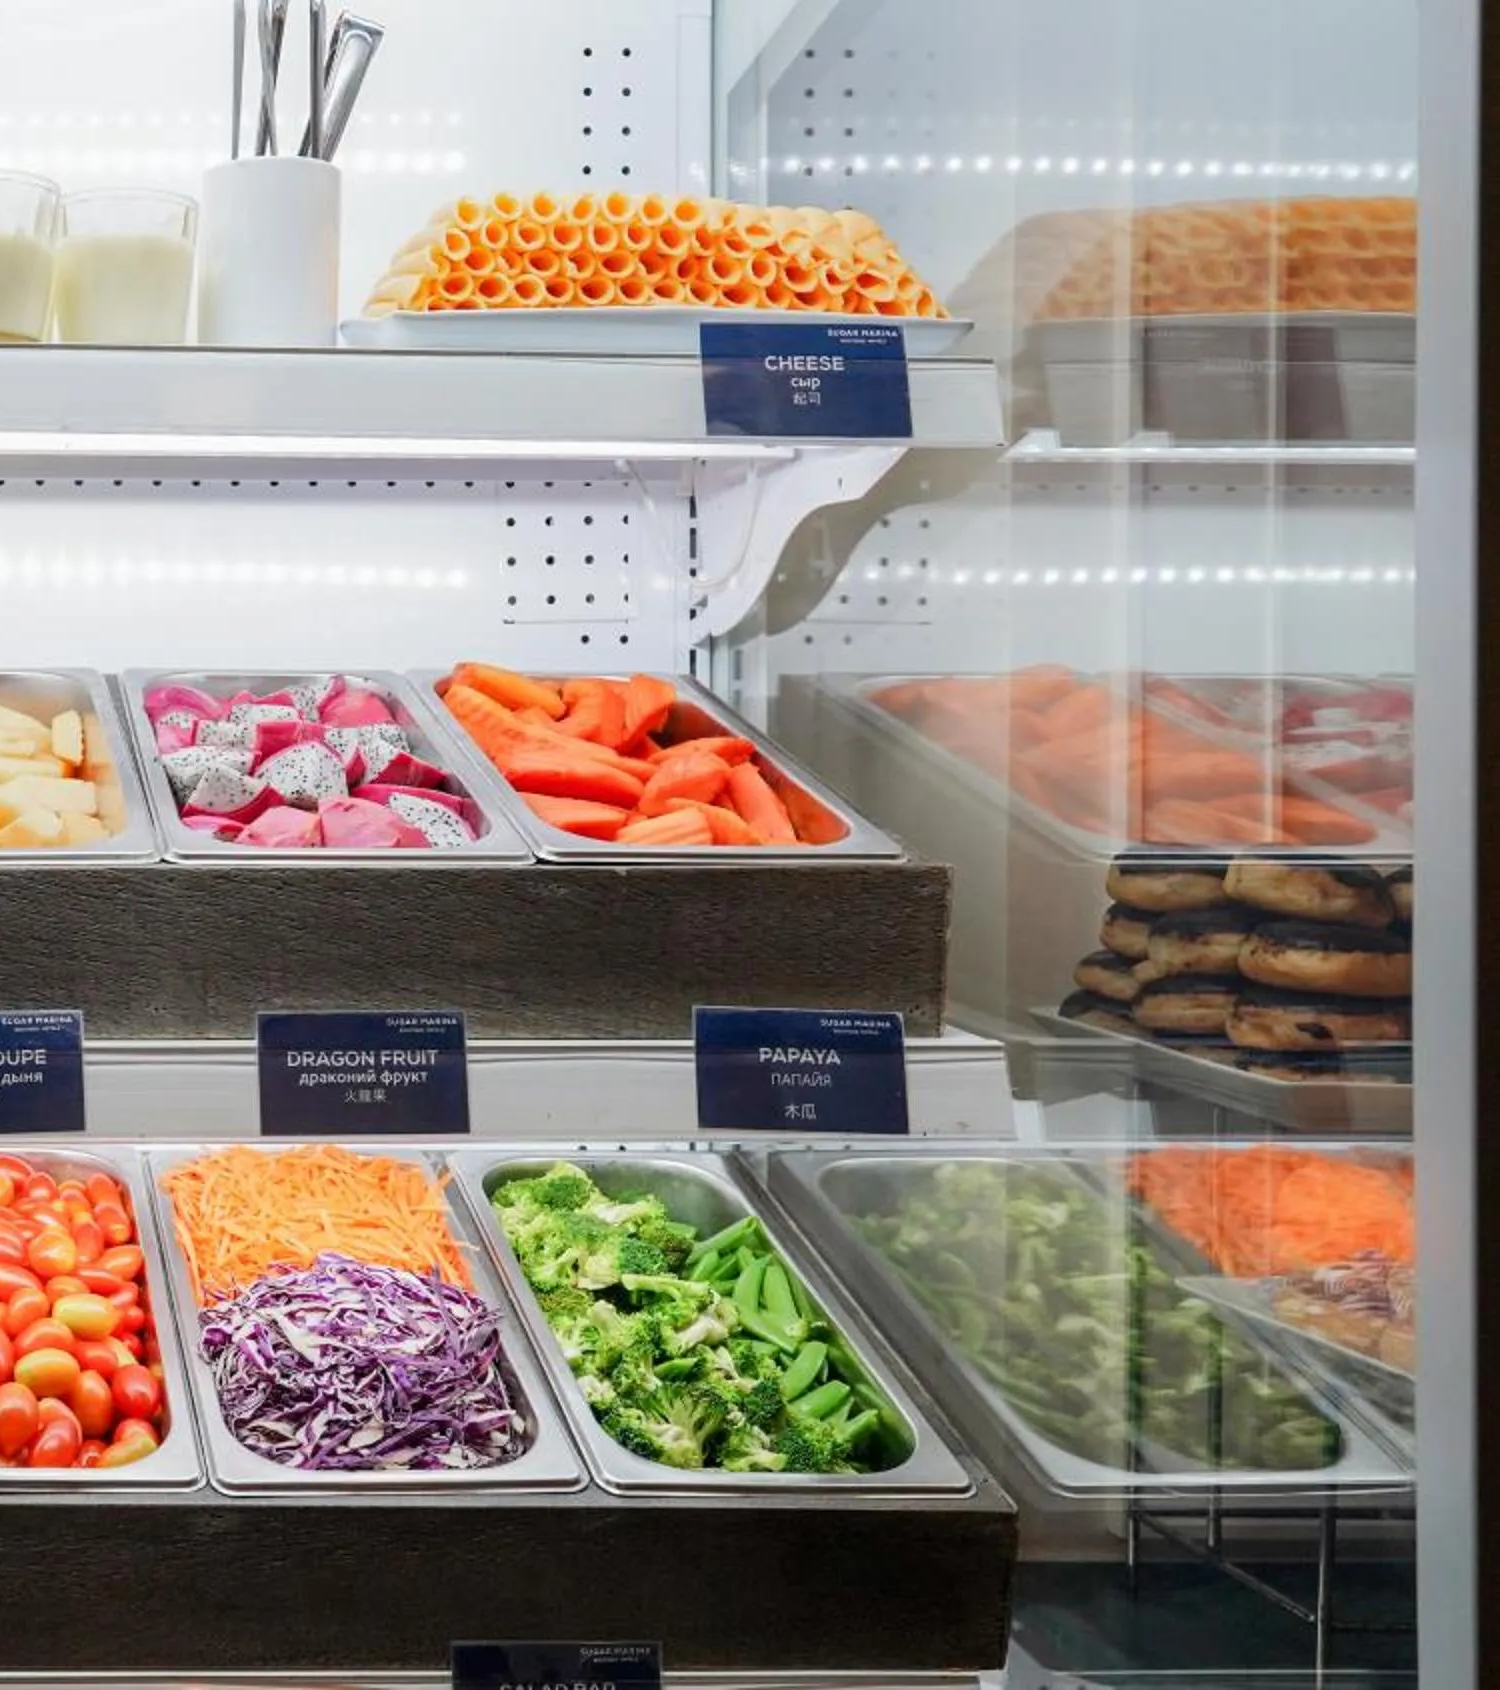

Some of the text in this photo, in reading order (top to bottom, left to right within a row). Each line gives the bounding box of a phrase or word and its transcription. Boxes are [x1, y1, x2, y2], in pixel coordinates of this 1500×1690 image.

[764, 355, 845, 371] CHEESE
[791, 377, 821, 390] сыр
[286, 1049, 439, 1067] DRAGON FRUIT
[759, 1047, 841, 1065] PAPAYA
[1, 1071, 44, 1085] дыня
[299, 1069, 429, 1086] драконий фрукт
[771, 1071, 833, 1087] ПАПАЙЯ
[784, 1103, 817, 1119] 木瓜
